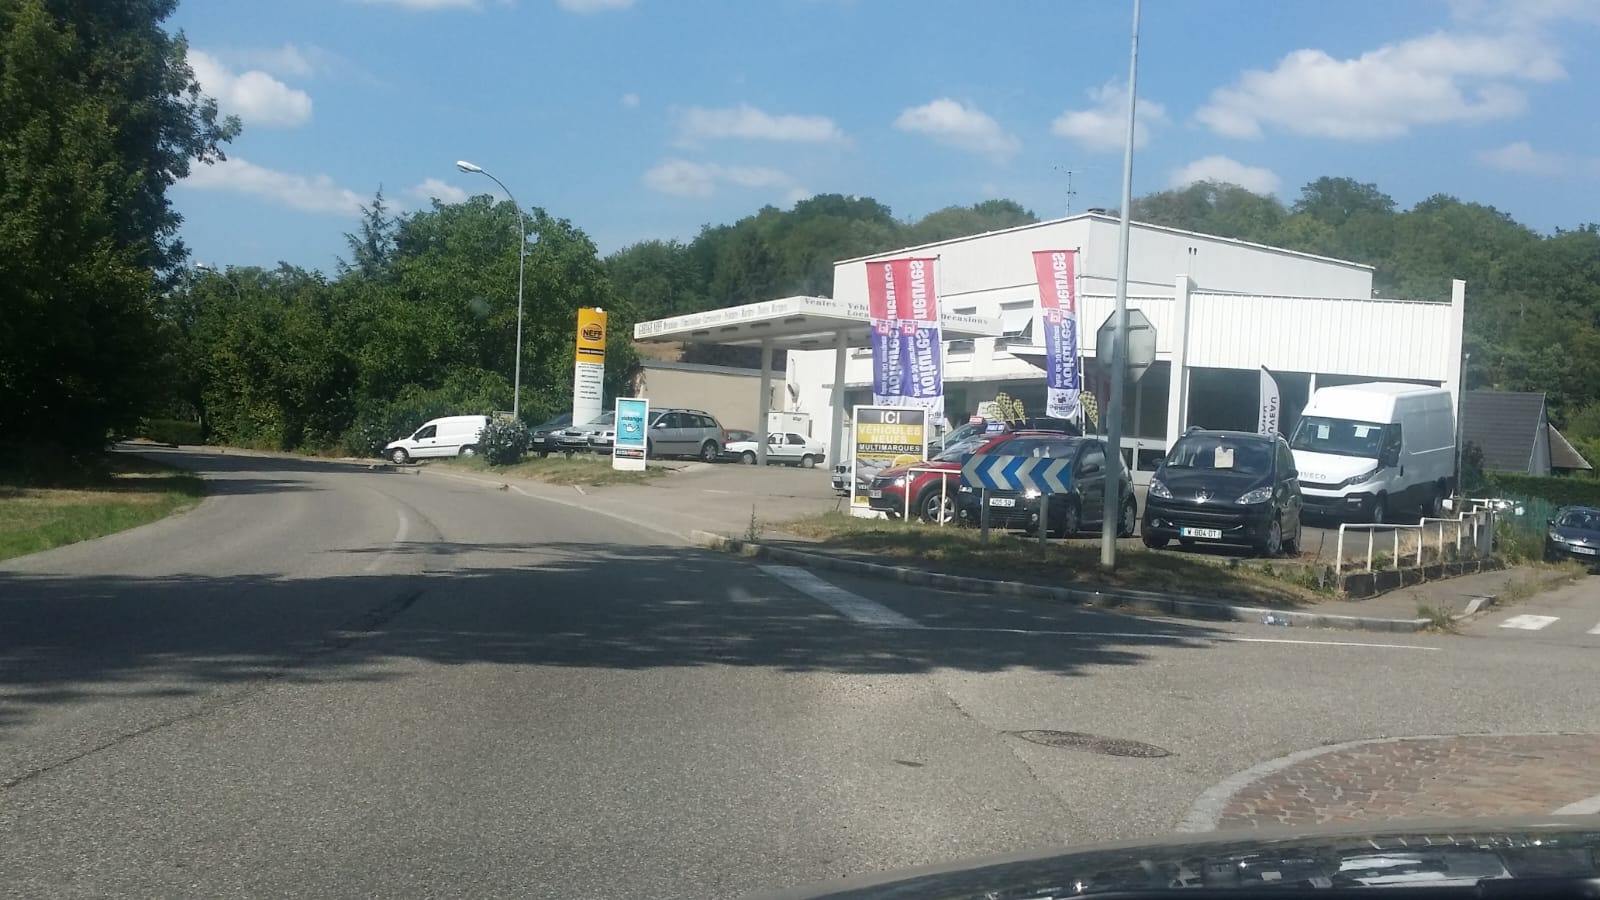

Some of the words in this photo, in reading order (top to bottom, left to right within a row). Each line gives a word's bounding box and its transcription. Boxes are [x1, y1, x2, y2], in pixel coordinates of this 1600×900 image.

[880, 411, 901, 424] ICI
[859, 444, 920, 452] MULTIMARQUES
[1300, 471, 1327, 480] IVECO
